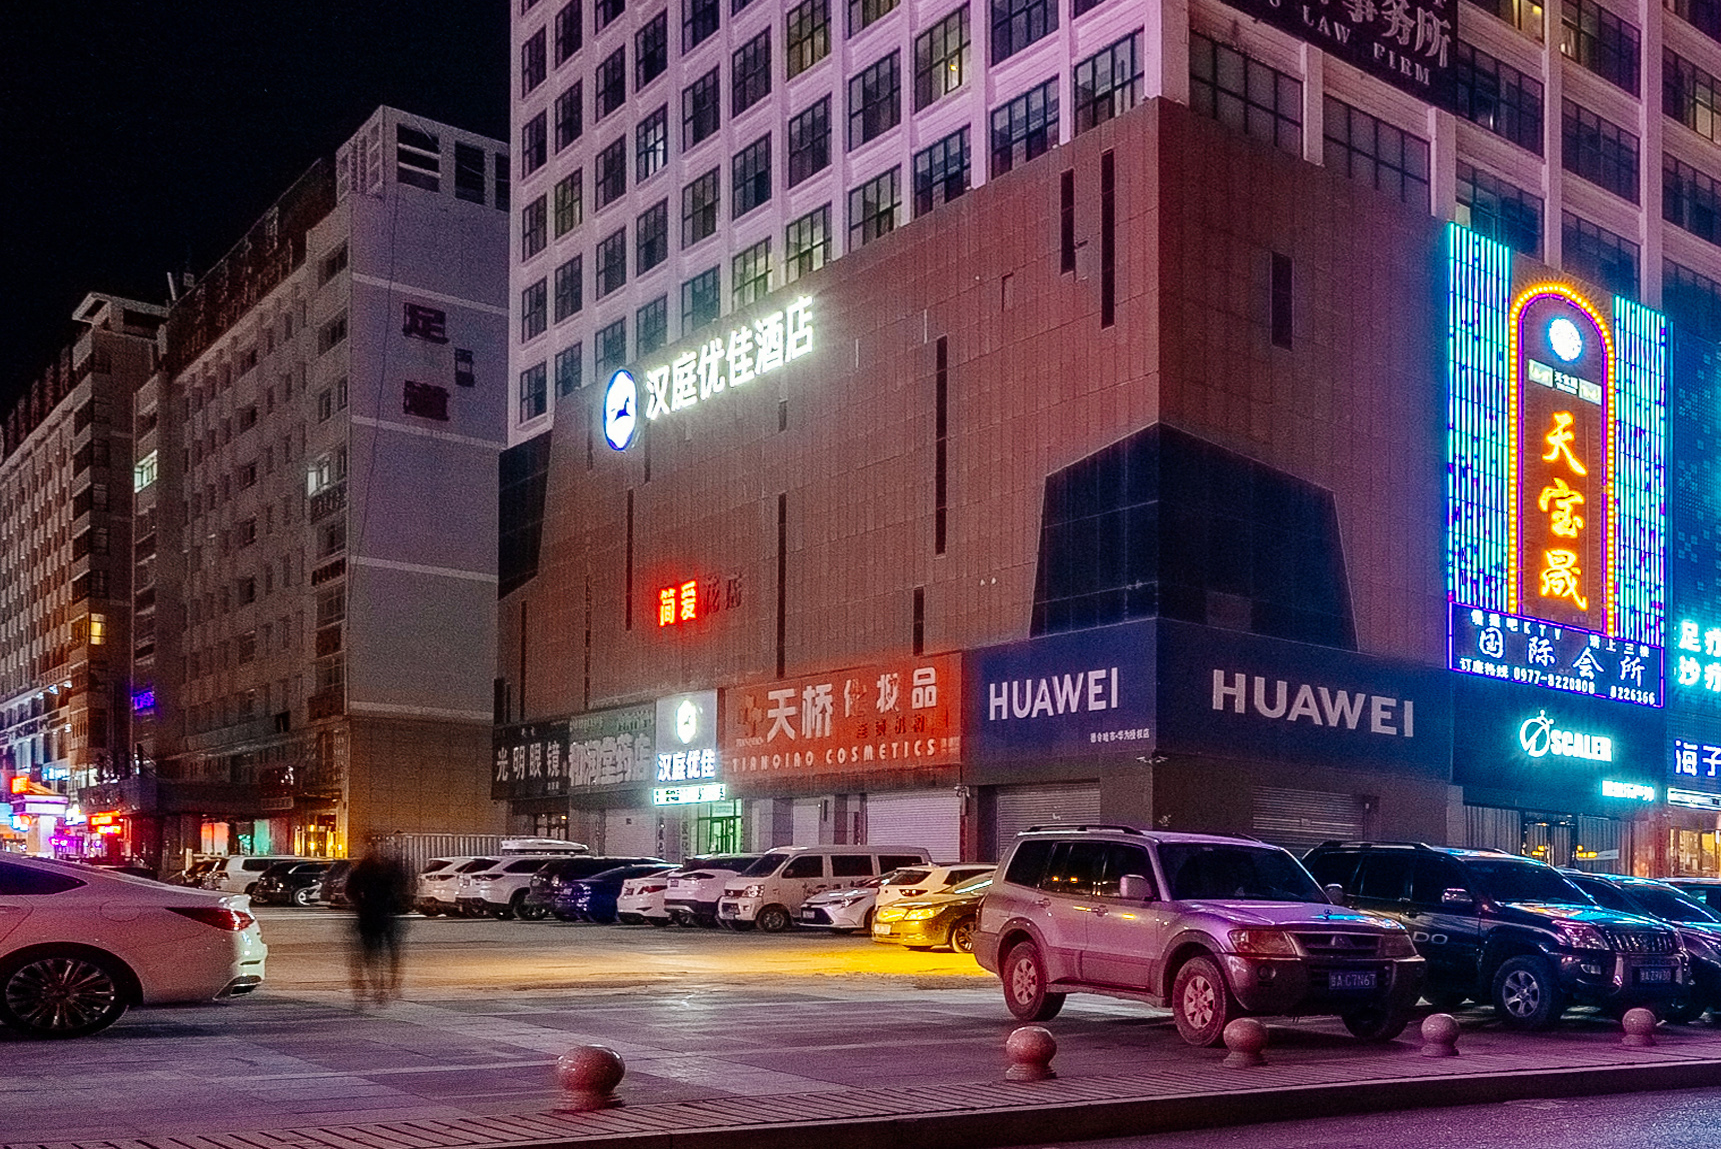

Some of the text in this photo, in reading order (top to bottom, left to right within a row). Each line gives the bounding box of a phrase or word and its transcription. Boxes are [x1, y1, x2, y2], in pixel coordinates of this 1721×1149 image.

[1302, 4, 1350, 44] LAW
[1373, 42, 1431, 86] FIRM
[646, 295, 813, 420] 汉庭优佳酒店
[1479, 627, 1645, 686] 国际会所
[989, 667, 1118, 720] HUAWEI
[1212, 669, 1413, 737] HUAWEI
[496, 740, 561, 782] 光明眼镜
[657, 749, 717, 782] 汉庭优佳
[826, 738, 937, 764] COSMETICS
